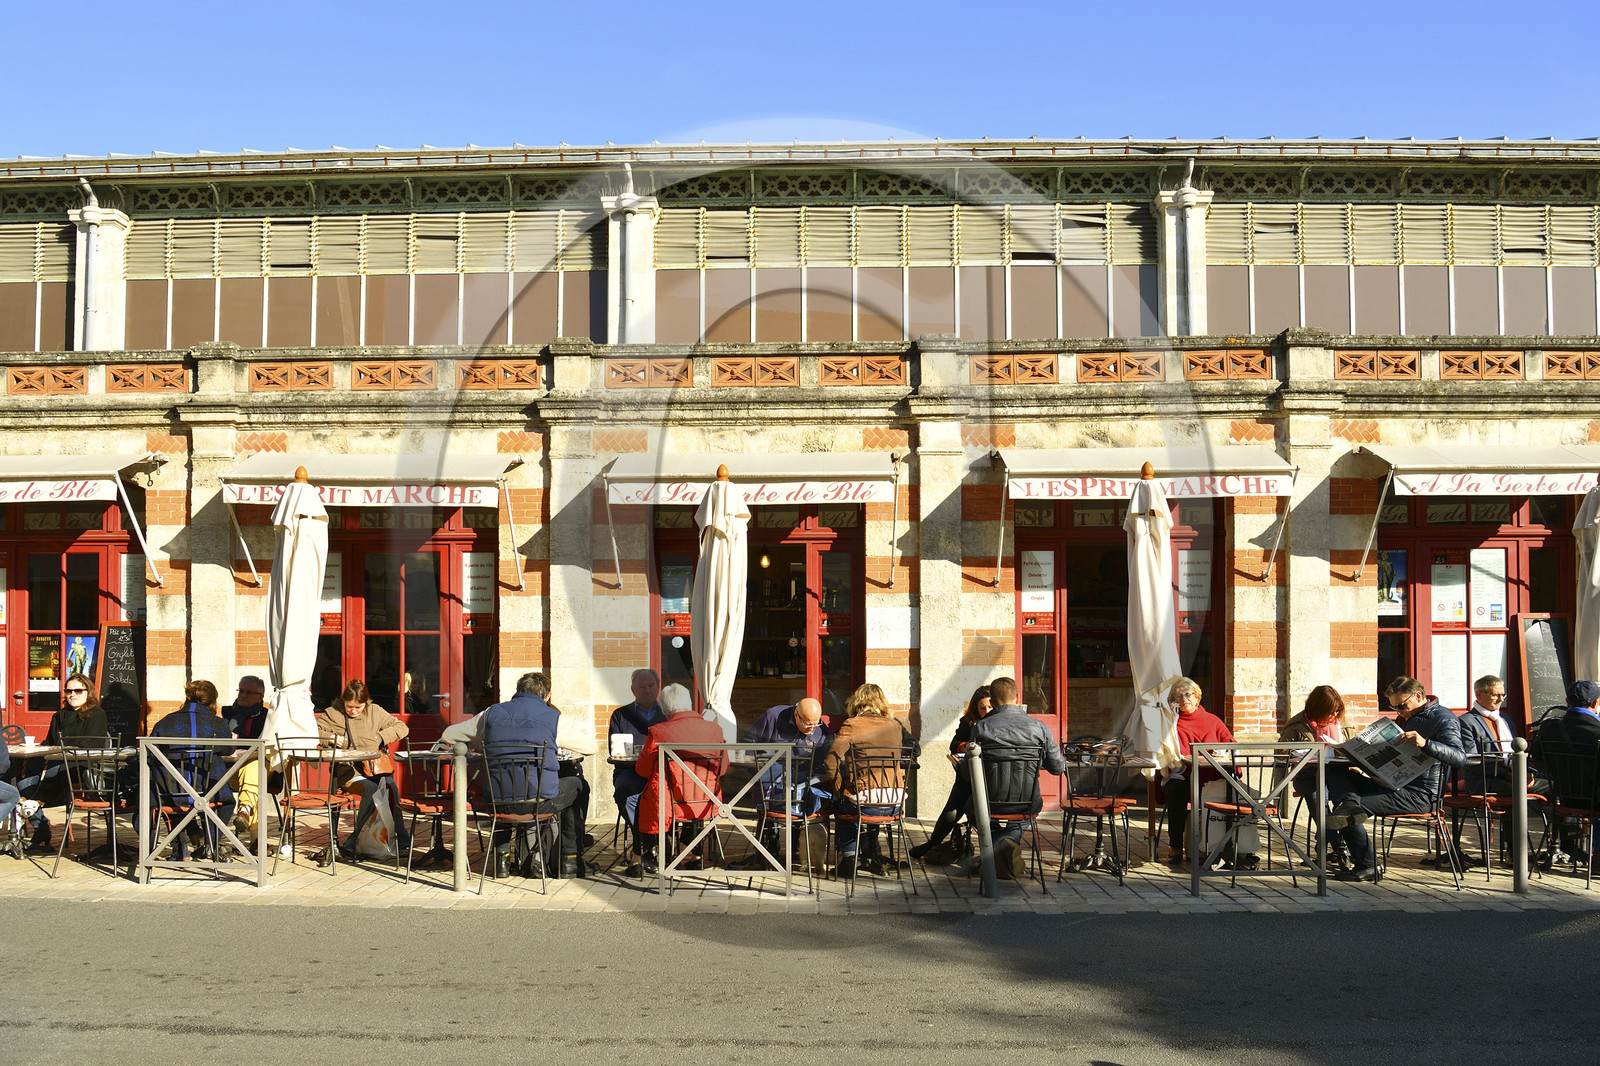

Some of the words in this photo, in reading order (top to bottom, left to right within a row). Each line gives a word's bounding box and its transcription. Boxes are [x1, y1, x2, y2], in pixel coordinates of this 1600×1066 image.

[14, 482, 42, 499] de
[49, 480, 98, 499] Blé
[238, 484, 351, 503] L'ESRIT
[362, 484, 482, 503] MARCHE
[625, 482, 657, 502] A
[661, 482, 700, 502] La
[786, 483, 816, 501] de
[823, 481, 875, 500] Blé
[1411, 473, 1442, 494] A
[1447, 473, 1481, 492] La
[1493, 473, 1559, 492] Gerbe
[1566, 474, 1593, 492] de
